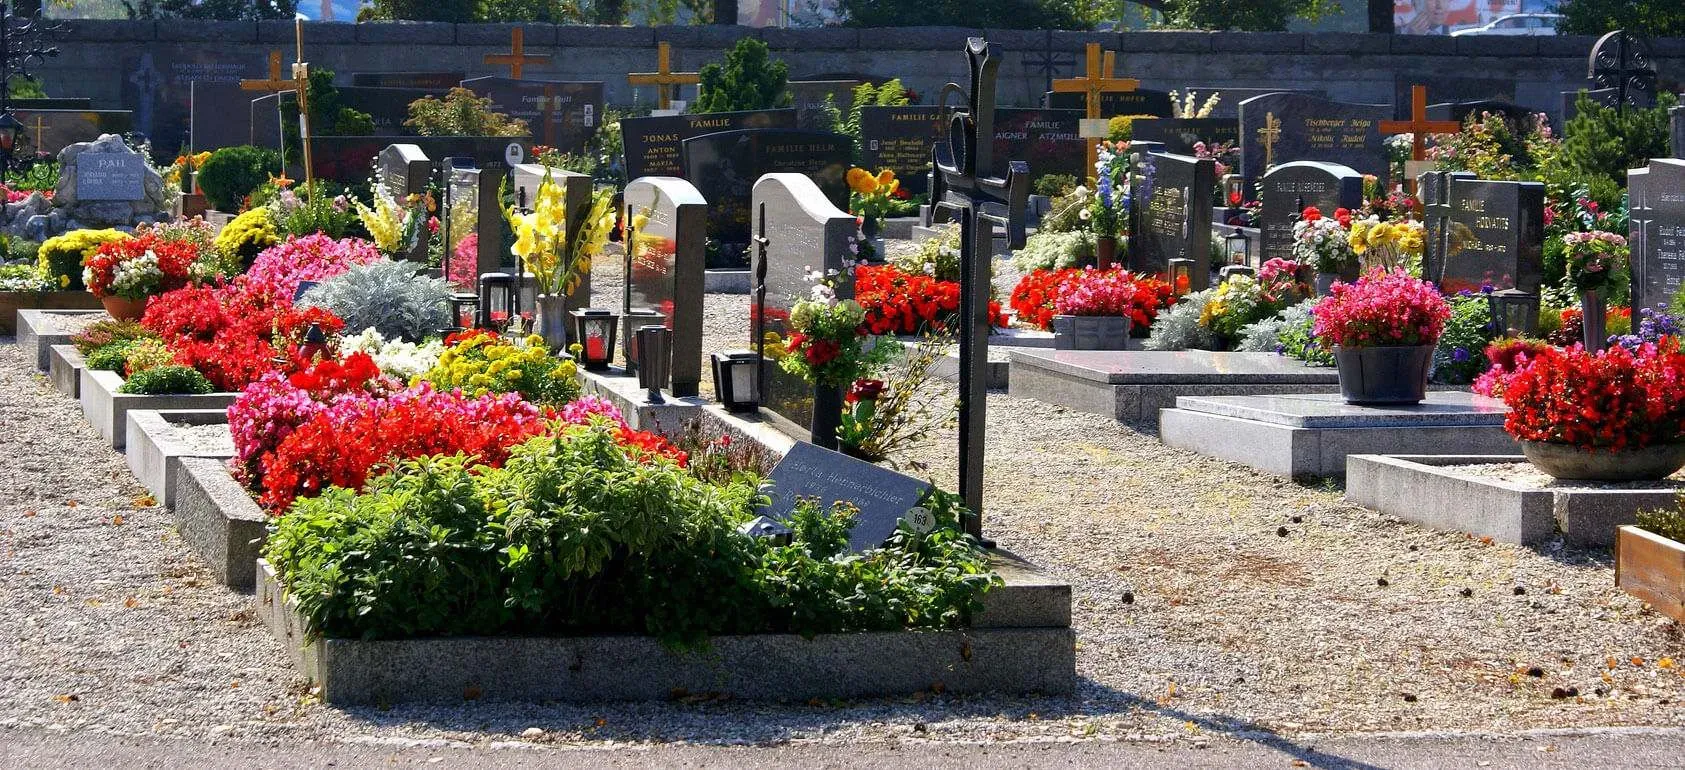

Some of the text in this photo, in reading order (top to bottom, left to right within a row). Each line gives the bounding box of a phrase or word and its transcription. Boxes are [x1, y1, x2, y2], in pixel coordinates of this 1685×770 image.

[690, 119, 731, 128] FAMILIE
[1025, 121, 1060, 129] FAMILIE
[642, 134, 679, 143] JONAS
[996, 131, 1028, 140] AIGNER
[914, 513, 928, 527] 163
